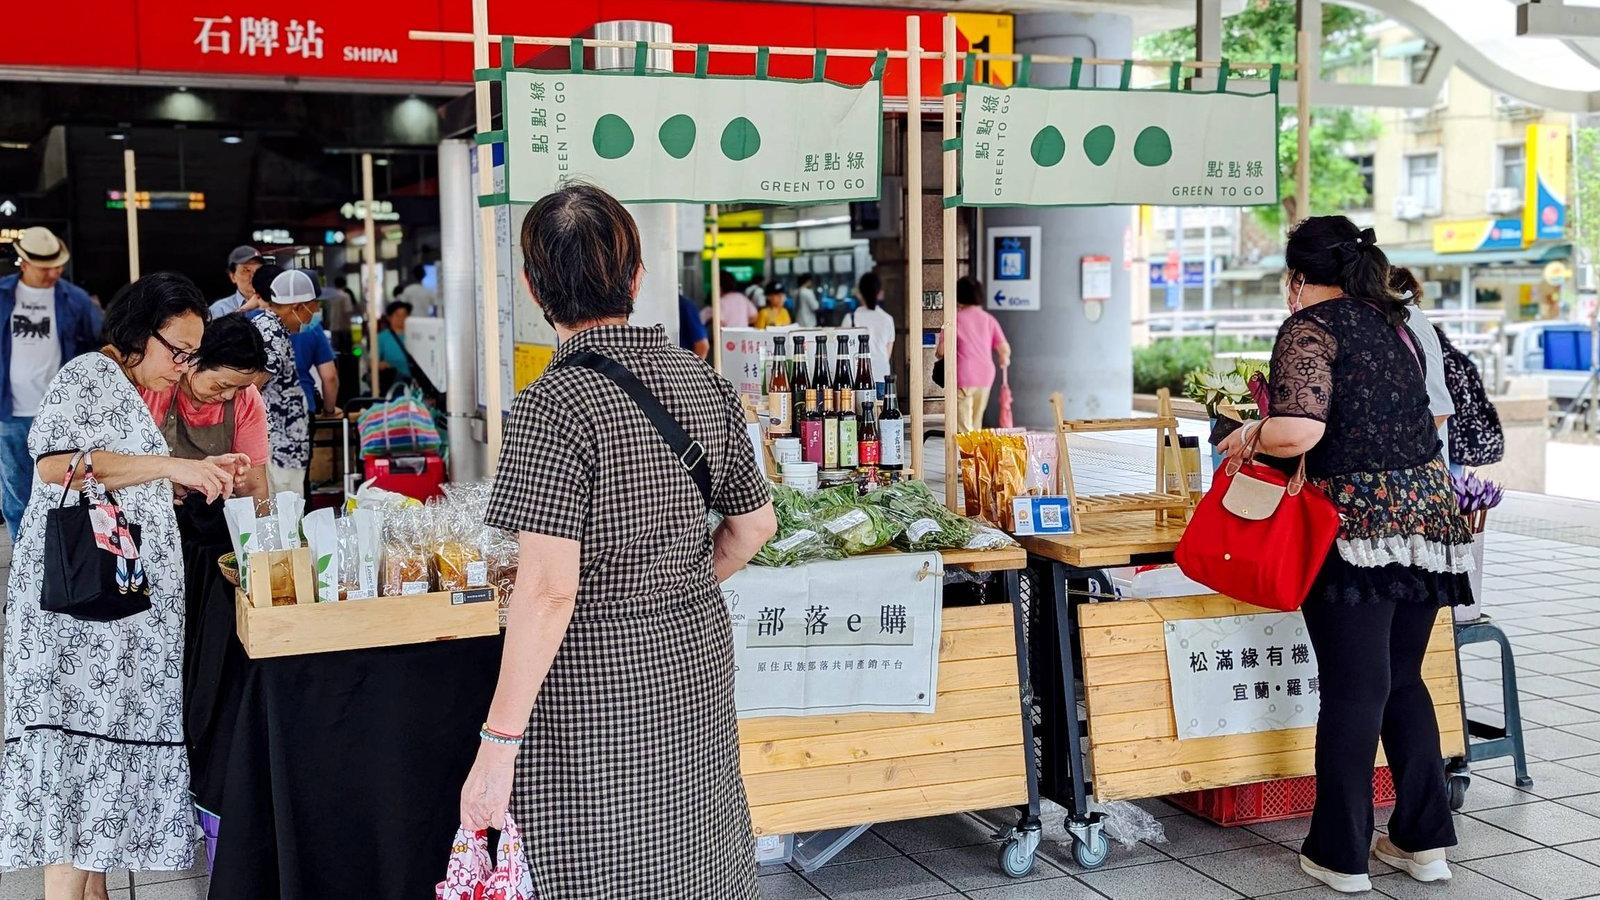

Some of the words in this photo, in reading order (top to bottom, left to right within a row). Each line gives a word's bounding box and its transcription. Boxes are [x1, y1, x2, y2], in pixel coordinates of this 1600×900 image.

[193, 15, 324, 59] 石牌站
[343, 46, 398, 64] SHIPAI
[971, 35, 990, 86] 1
[554, 81, 566, 103] GO
[1001, 94, 1011, 114] GO
[530, 81, 549, 154] 點點綠
[556, 112, 567, 133] TO
[975, 95, 1000, 160] 點點綠
[997, 122, 1007, 140] TO
[557, 142, 569, 183] REEN
[803, 151, 865, 172] 點點綠
[994, 148, 1005, 196] GREEN
[1206, 160, 1263, 178] 點點綠
[760, 180, 810, 192] GREEN
[817, 179, 835, 190] TO
[843, 178, 865, 190] GO
[1172, 185, 1213, 196] GREEN
[1221, 186, 1237, 196] TO
[1243, 185, 1264, 196] GO
[757, 604, 907, 636] 部落e購
[757, 658, 903, 672] 原住民族部落共同產銷平台
[1189, 643, 1310, 673] 松滿緣有機
